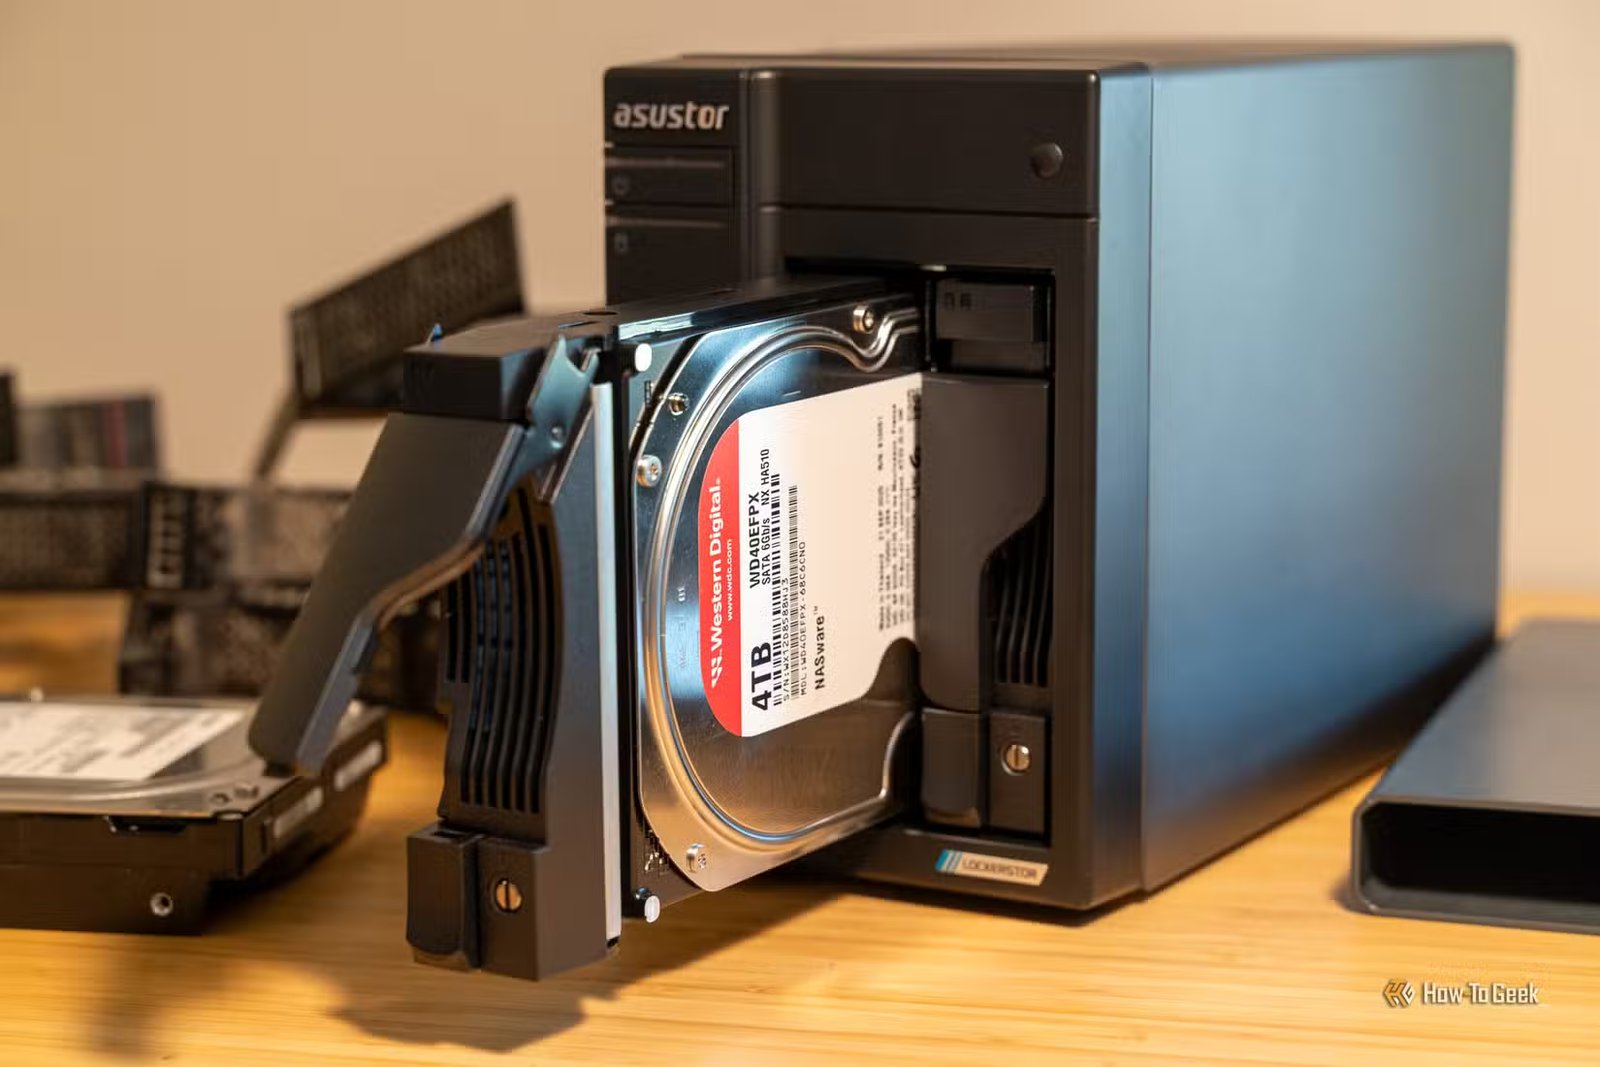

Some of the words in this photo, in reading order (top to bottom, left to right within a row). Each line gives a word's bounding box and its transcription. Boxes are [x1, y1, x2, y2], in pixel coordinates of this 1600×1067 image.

[613, 101, 729, 131] asustor
[760, 448, 770, 486] HA510
[760, 489, 771, 505] NX
[749, 492, 760, 588] WD40EFPX
[761, 518, 770, 550] 6Gb/s
[761, 554, 770, 585] SATA
[711, 560, 722, 653] Western
[751, 642, 772, 710] 4TB
